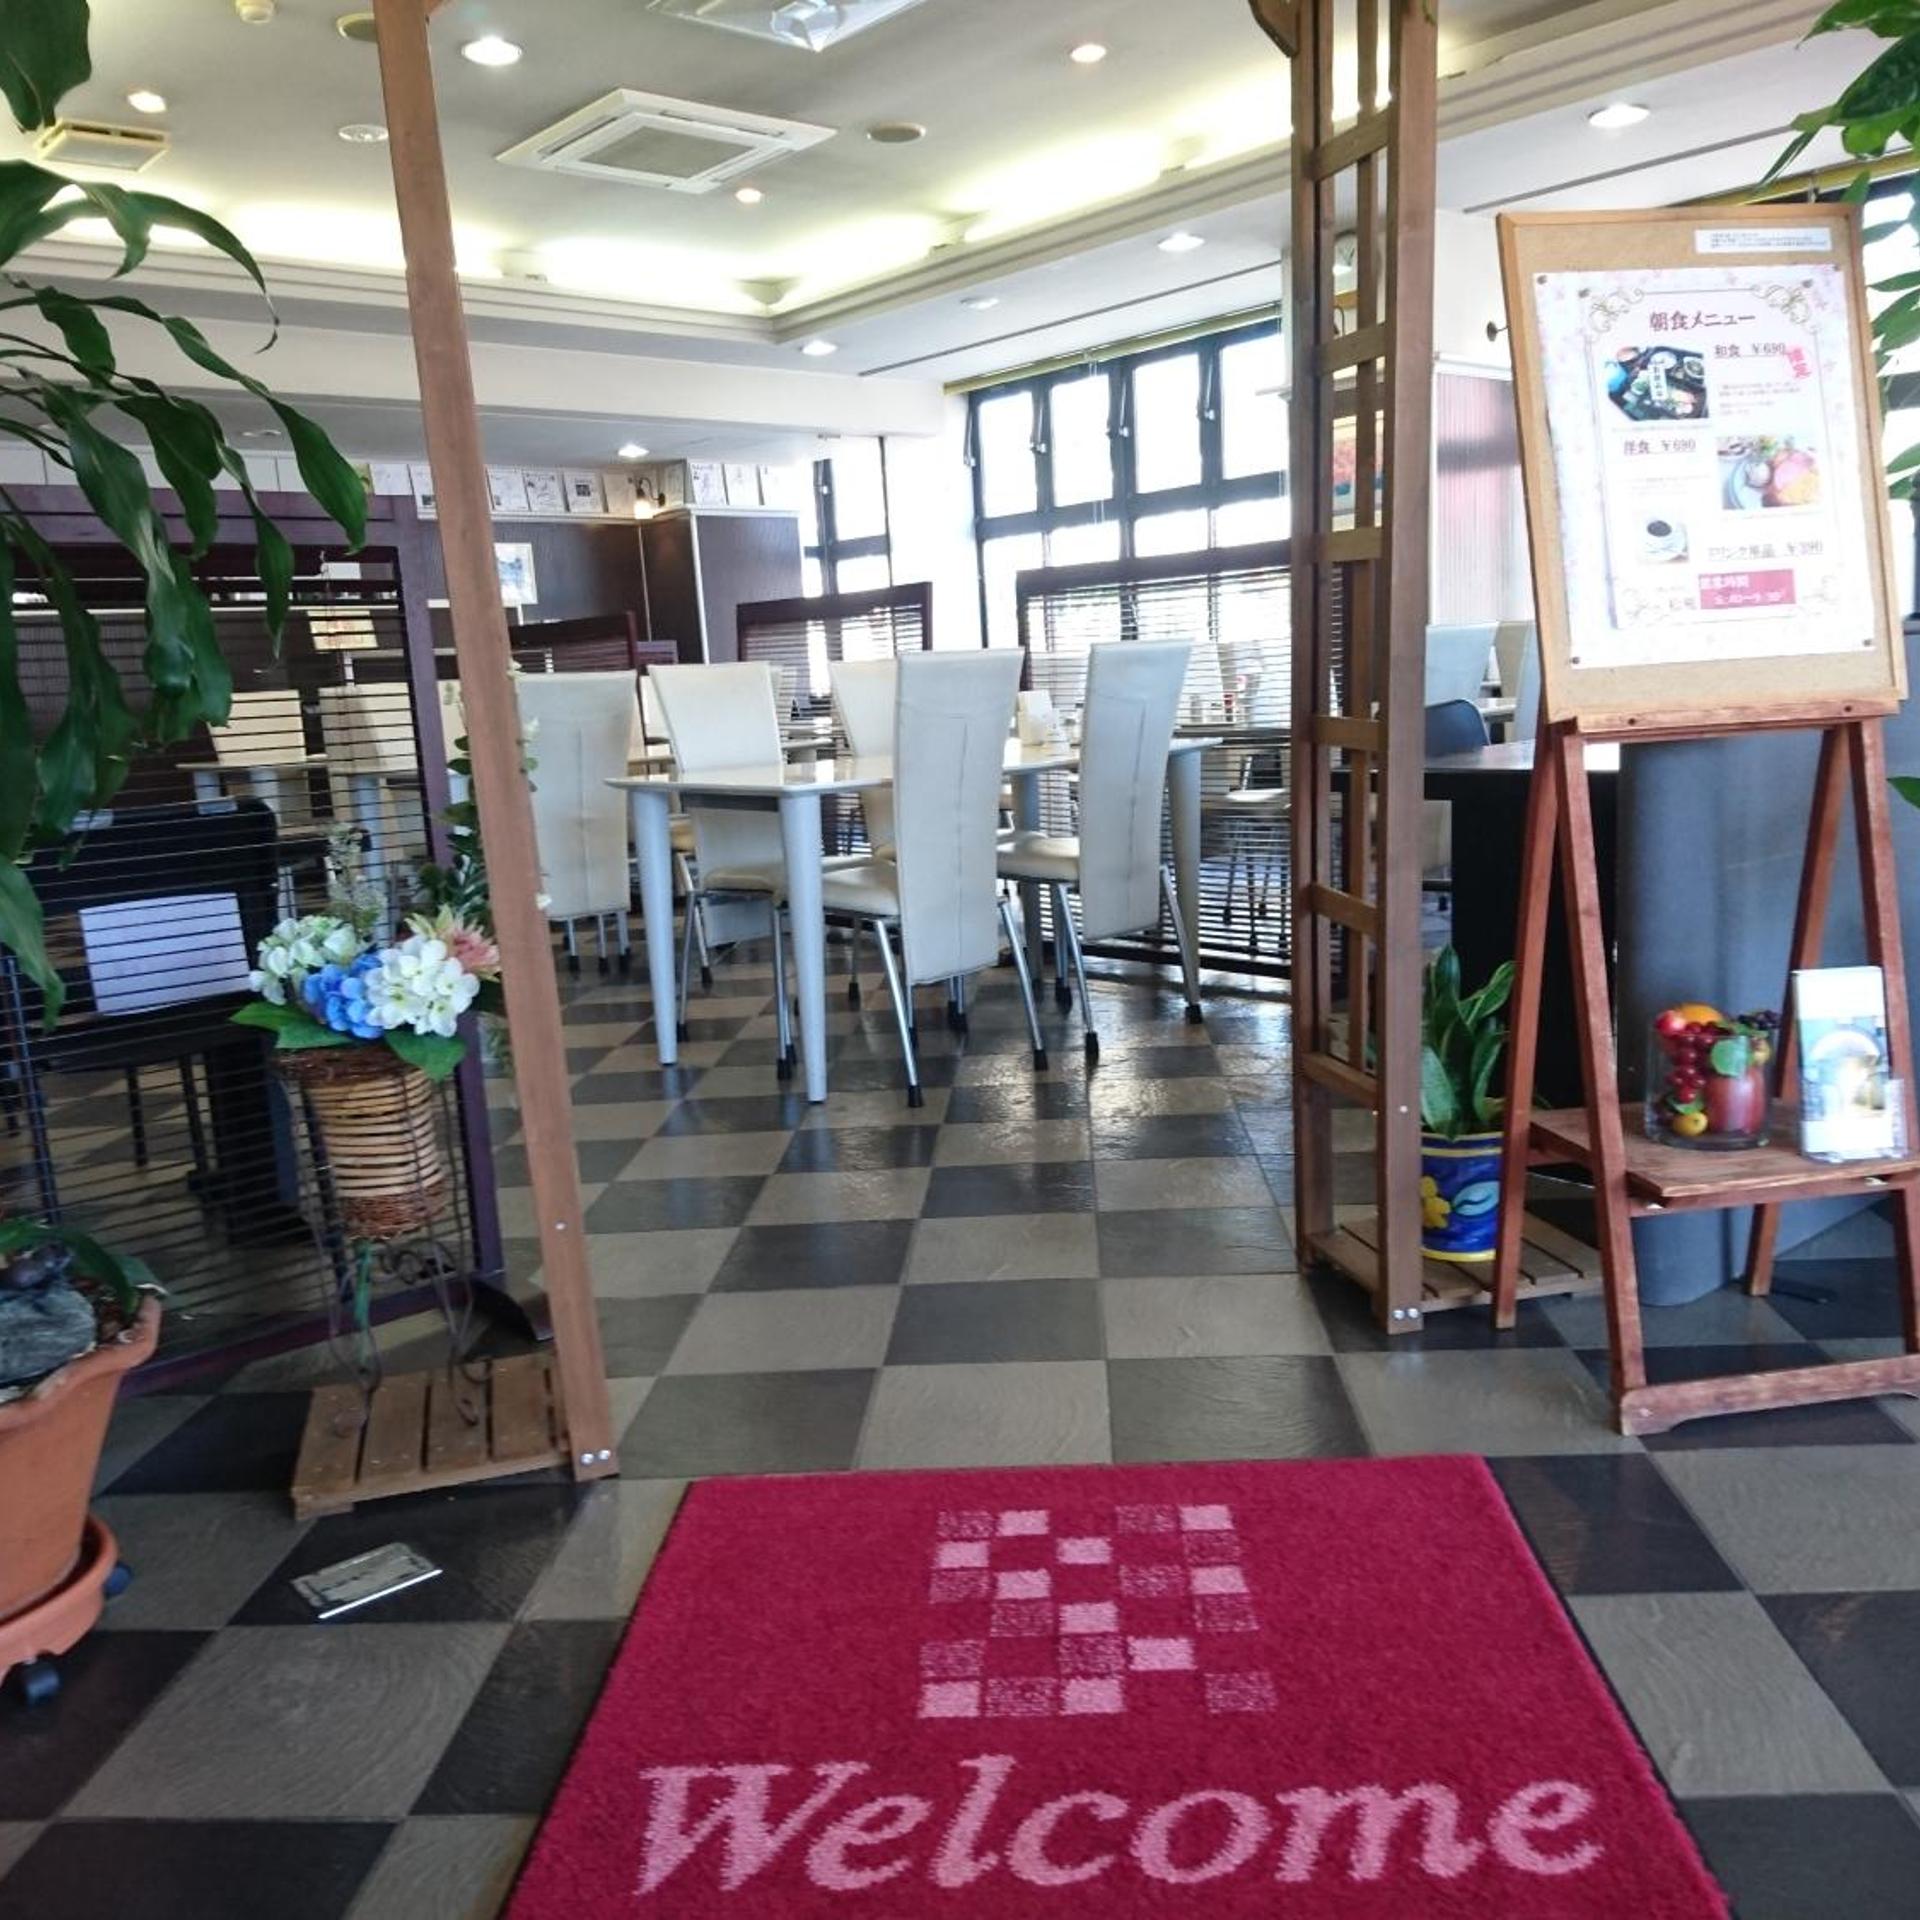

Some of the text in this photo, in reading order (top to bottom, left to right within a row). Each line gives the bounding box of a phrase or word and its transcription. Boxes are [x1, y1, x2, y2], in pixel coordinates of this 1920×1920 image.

[1649, 310, 1756, 332] 朝食メニュー
[1715, 343, 1741, 358] 和食
[632, 1753, 1605, 1896] Welcome
